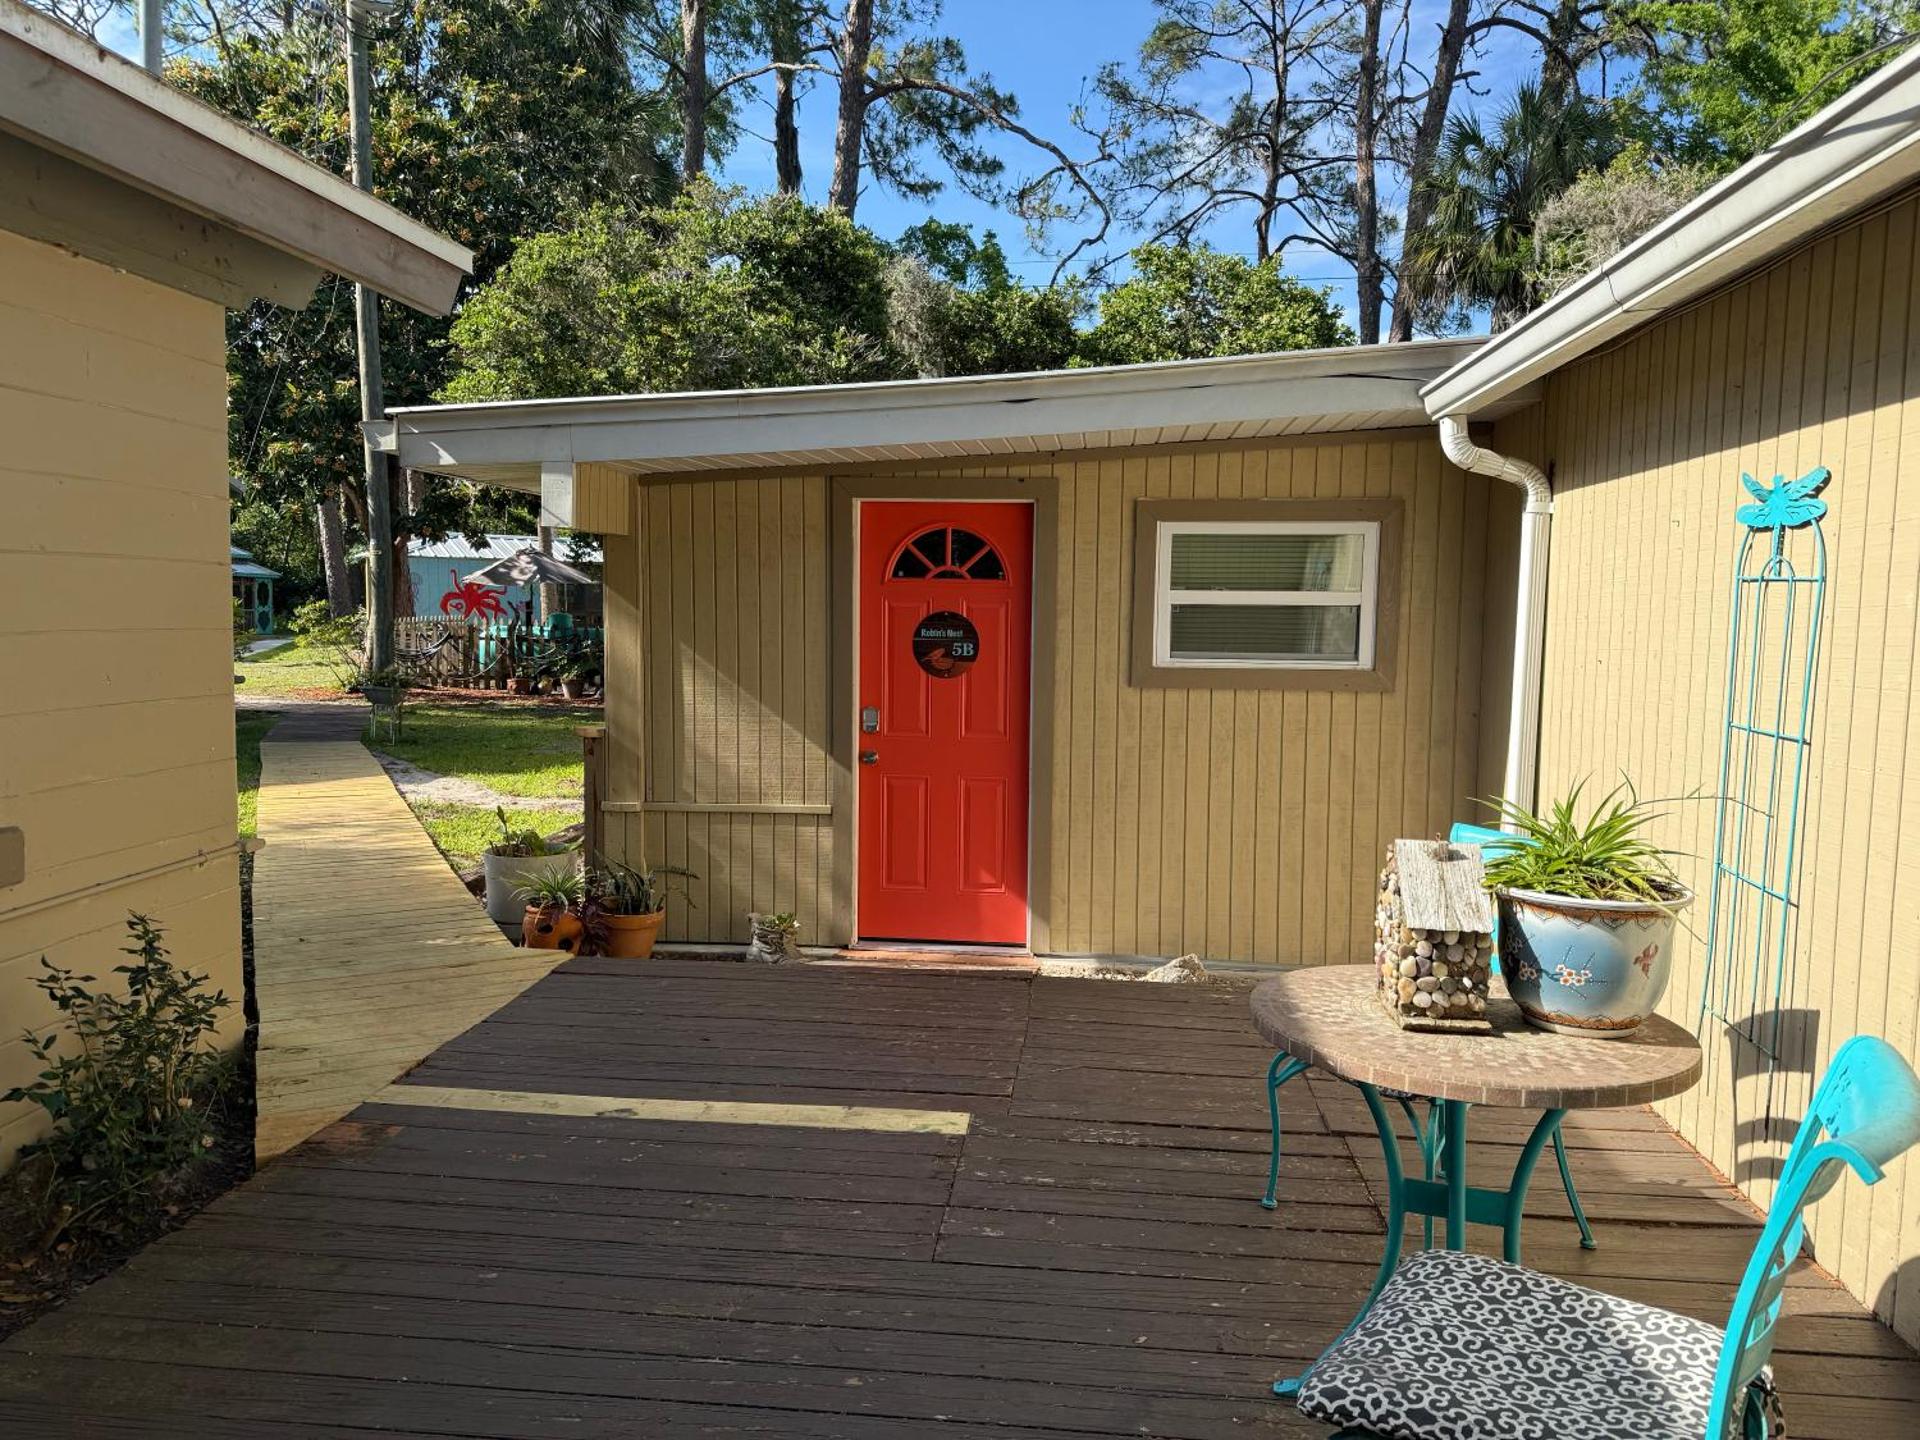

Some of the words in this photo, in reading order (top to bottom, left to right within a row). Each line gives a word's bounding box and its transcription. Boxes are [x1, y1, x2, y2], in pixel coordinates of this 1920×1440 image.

[921, 628, 946, 637] Robin's
[946, 629, 963, 638] Nest
[951, 642, 975, 656] 5B
